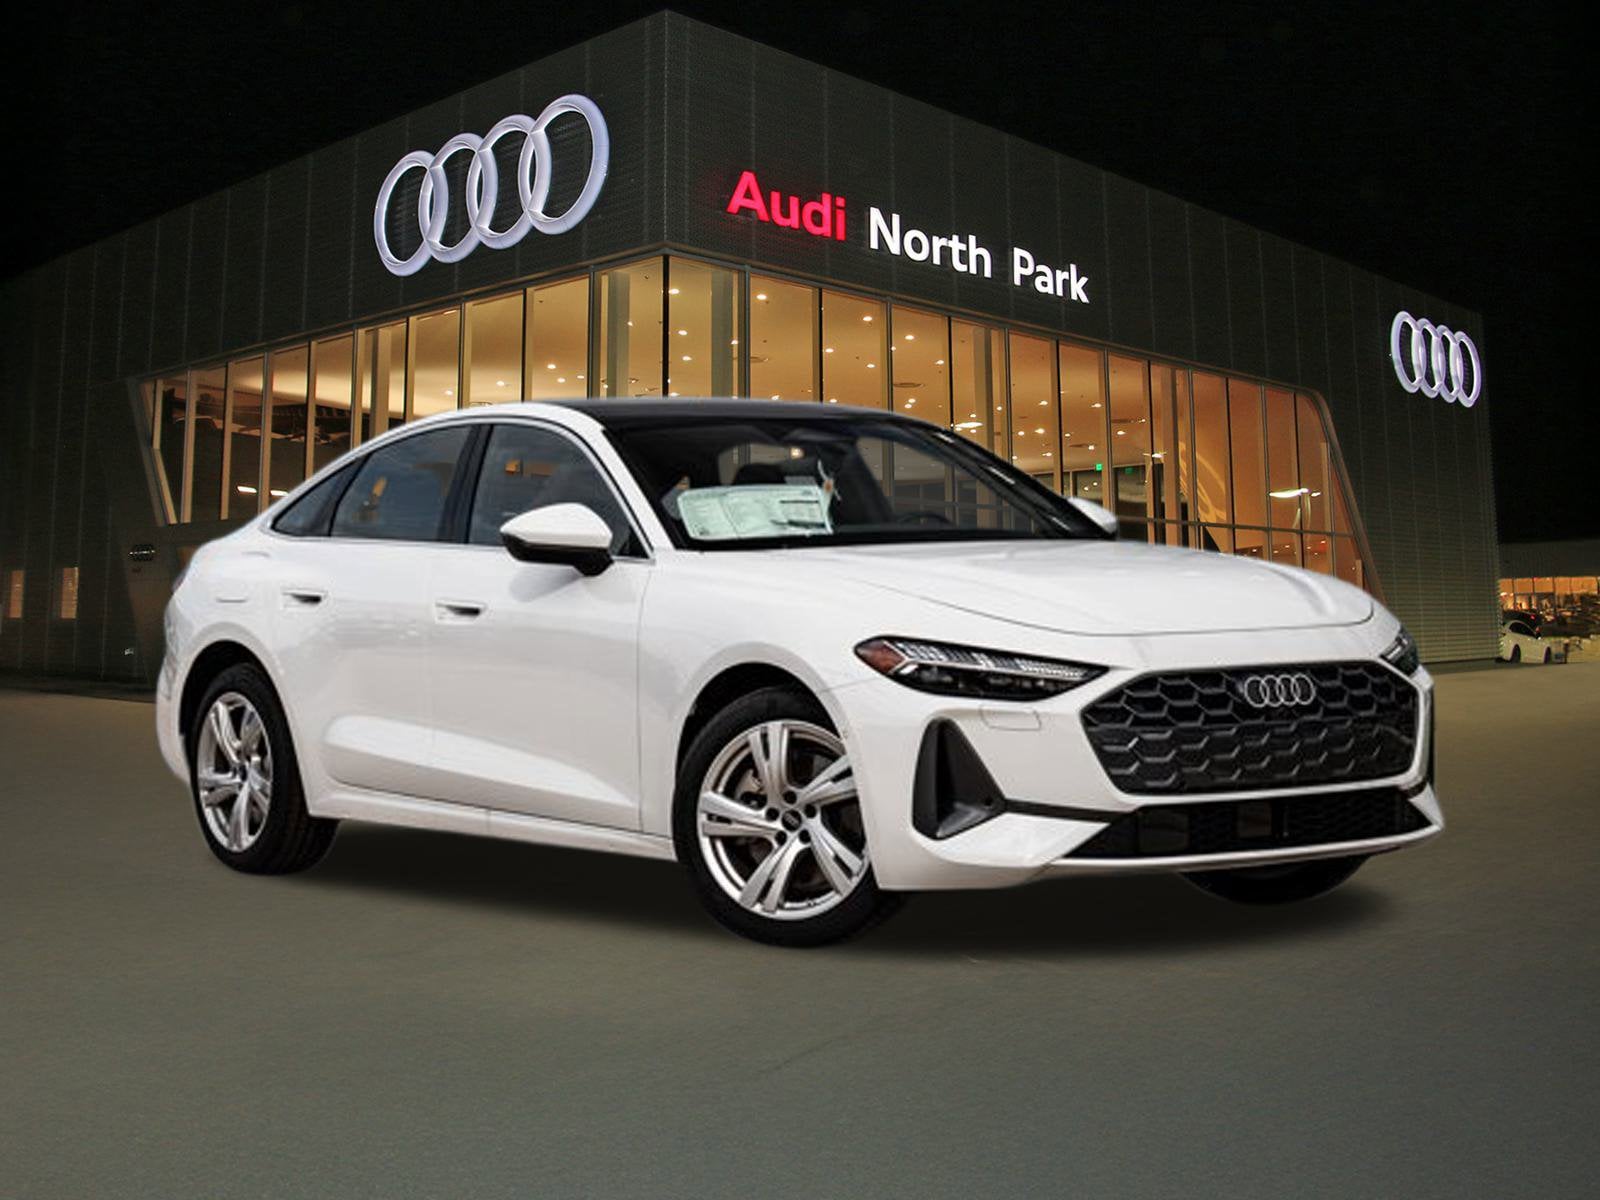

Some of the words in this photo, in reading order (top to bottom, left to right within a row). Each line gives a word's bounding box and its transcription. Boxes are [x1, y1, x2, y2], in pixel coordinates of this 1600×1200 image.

[726, 170, 846, 241] Audi
[869, 206, 992, 278] North
[1013, 247, 1090, 304] Park
